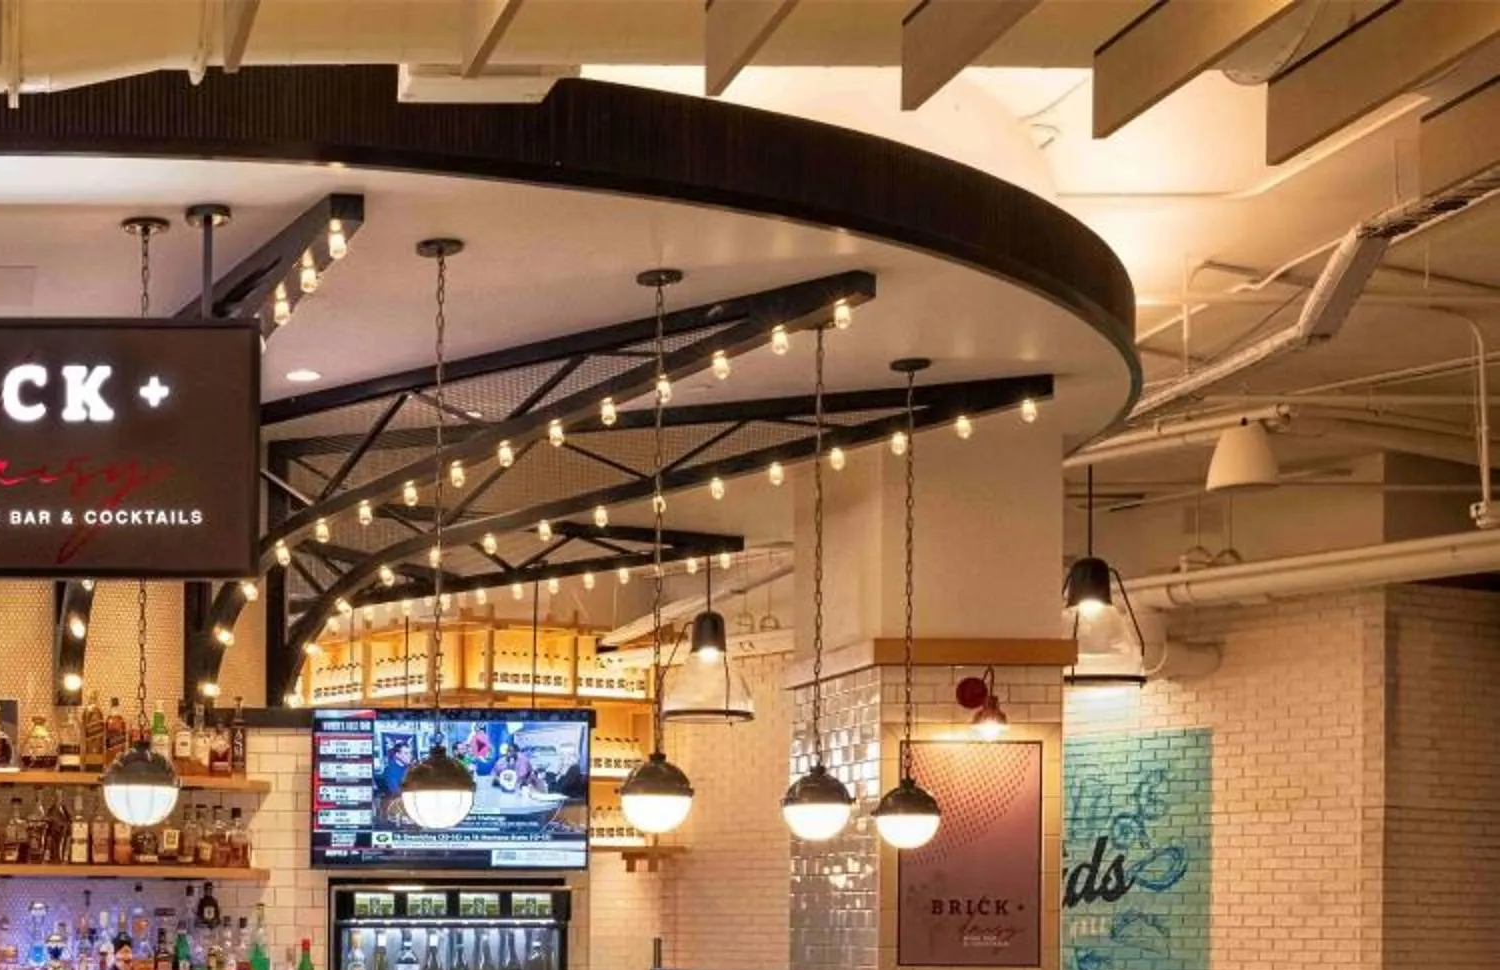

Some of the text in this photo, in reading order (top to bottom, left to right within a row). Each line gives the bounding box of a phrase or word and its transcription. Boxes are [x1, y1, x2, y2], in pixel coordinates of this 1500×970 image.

[10, 510, 52, 525] BAR
[61, 510, 74, 525] &
[84, 510, 203, 525] COCKTAILS
[931, 899, 1008, 916] BRICK
